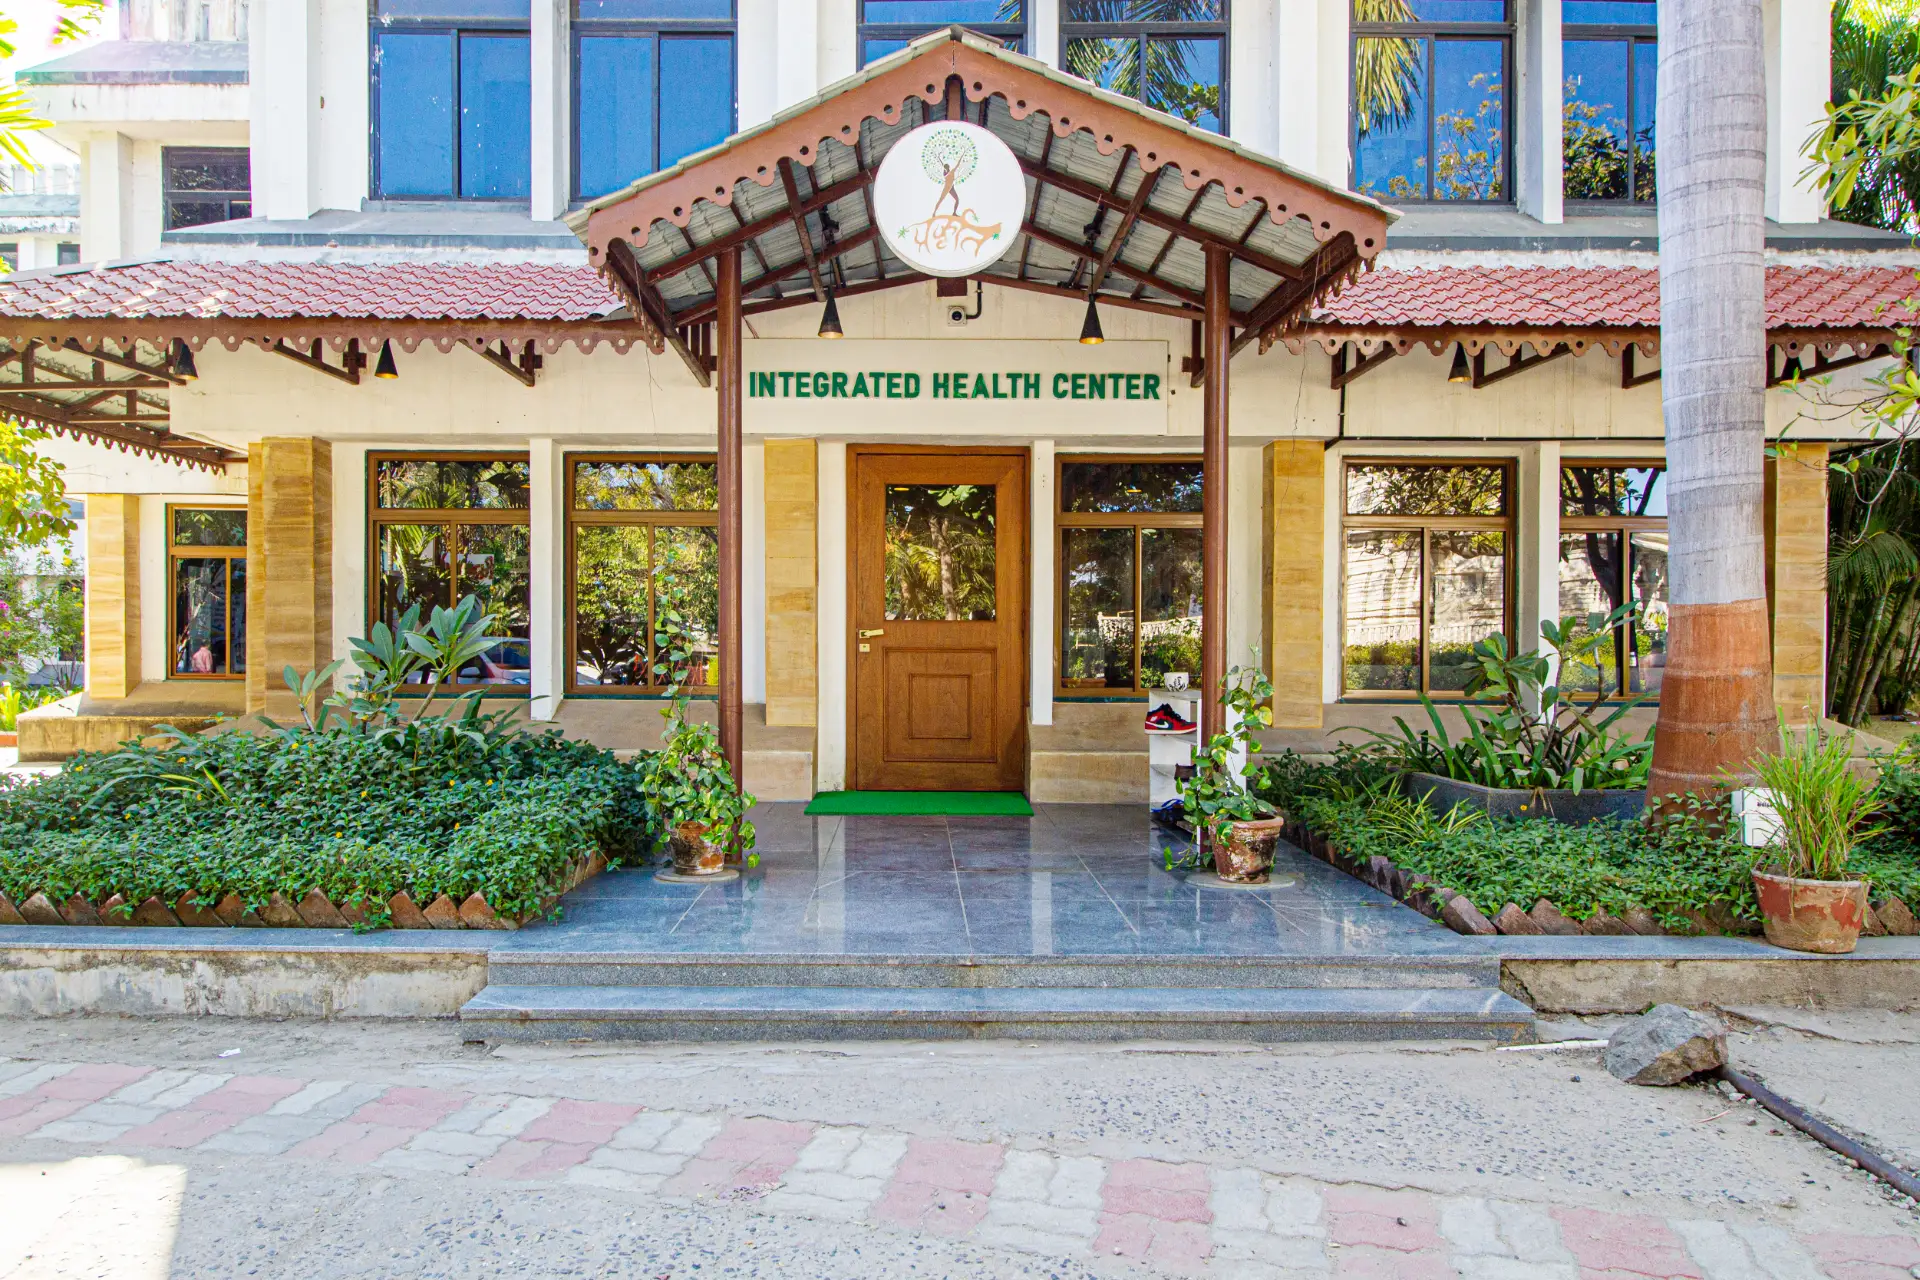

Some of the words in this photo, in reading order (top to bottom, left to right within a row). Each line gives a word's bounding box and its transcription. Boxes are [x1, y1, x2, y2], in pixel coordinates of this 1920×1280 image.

[749, 371, 920, 398] INTEGRATED
[932, 373, 1040, 398] HEALTH
[1053, 374, 1160, 399] CENTER
